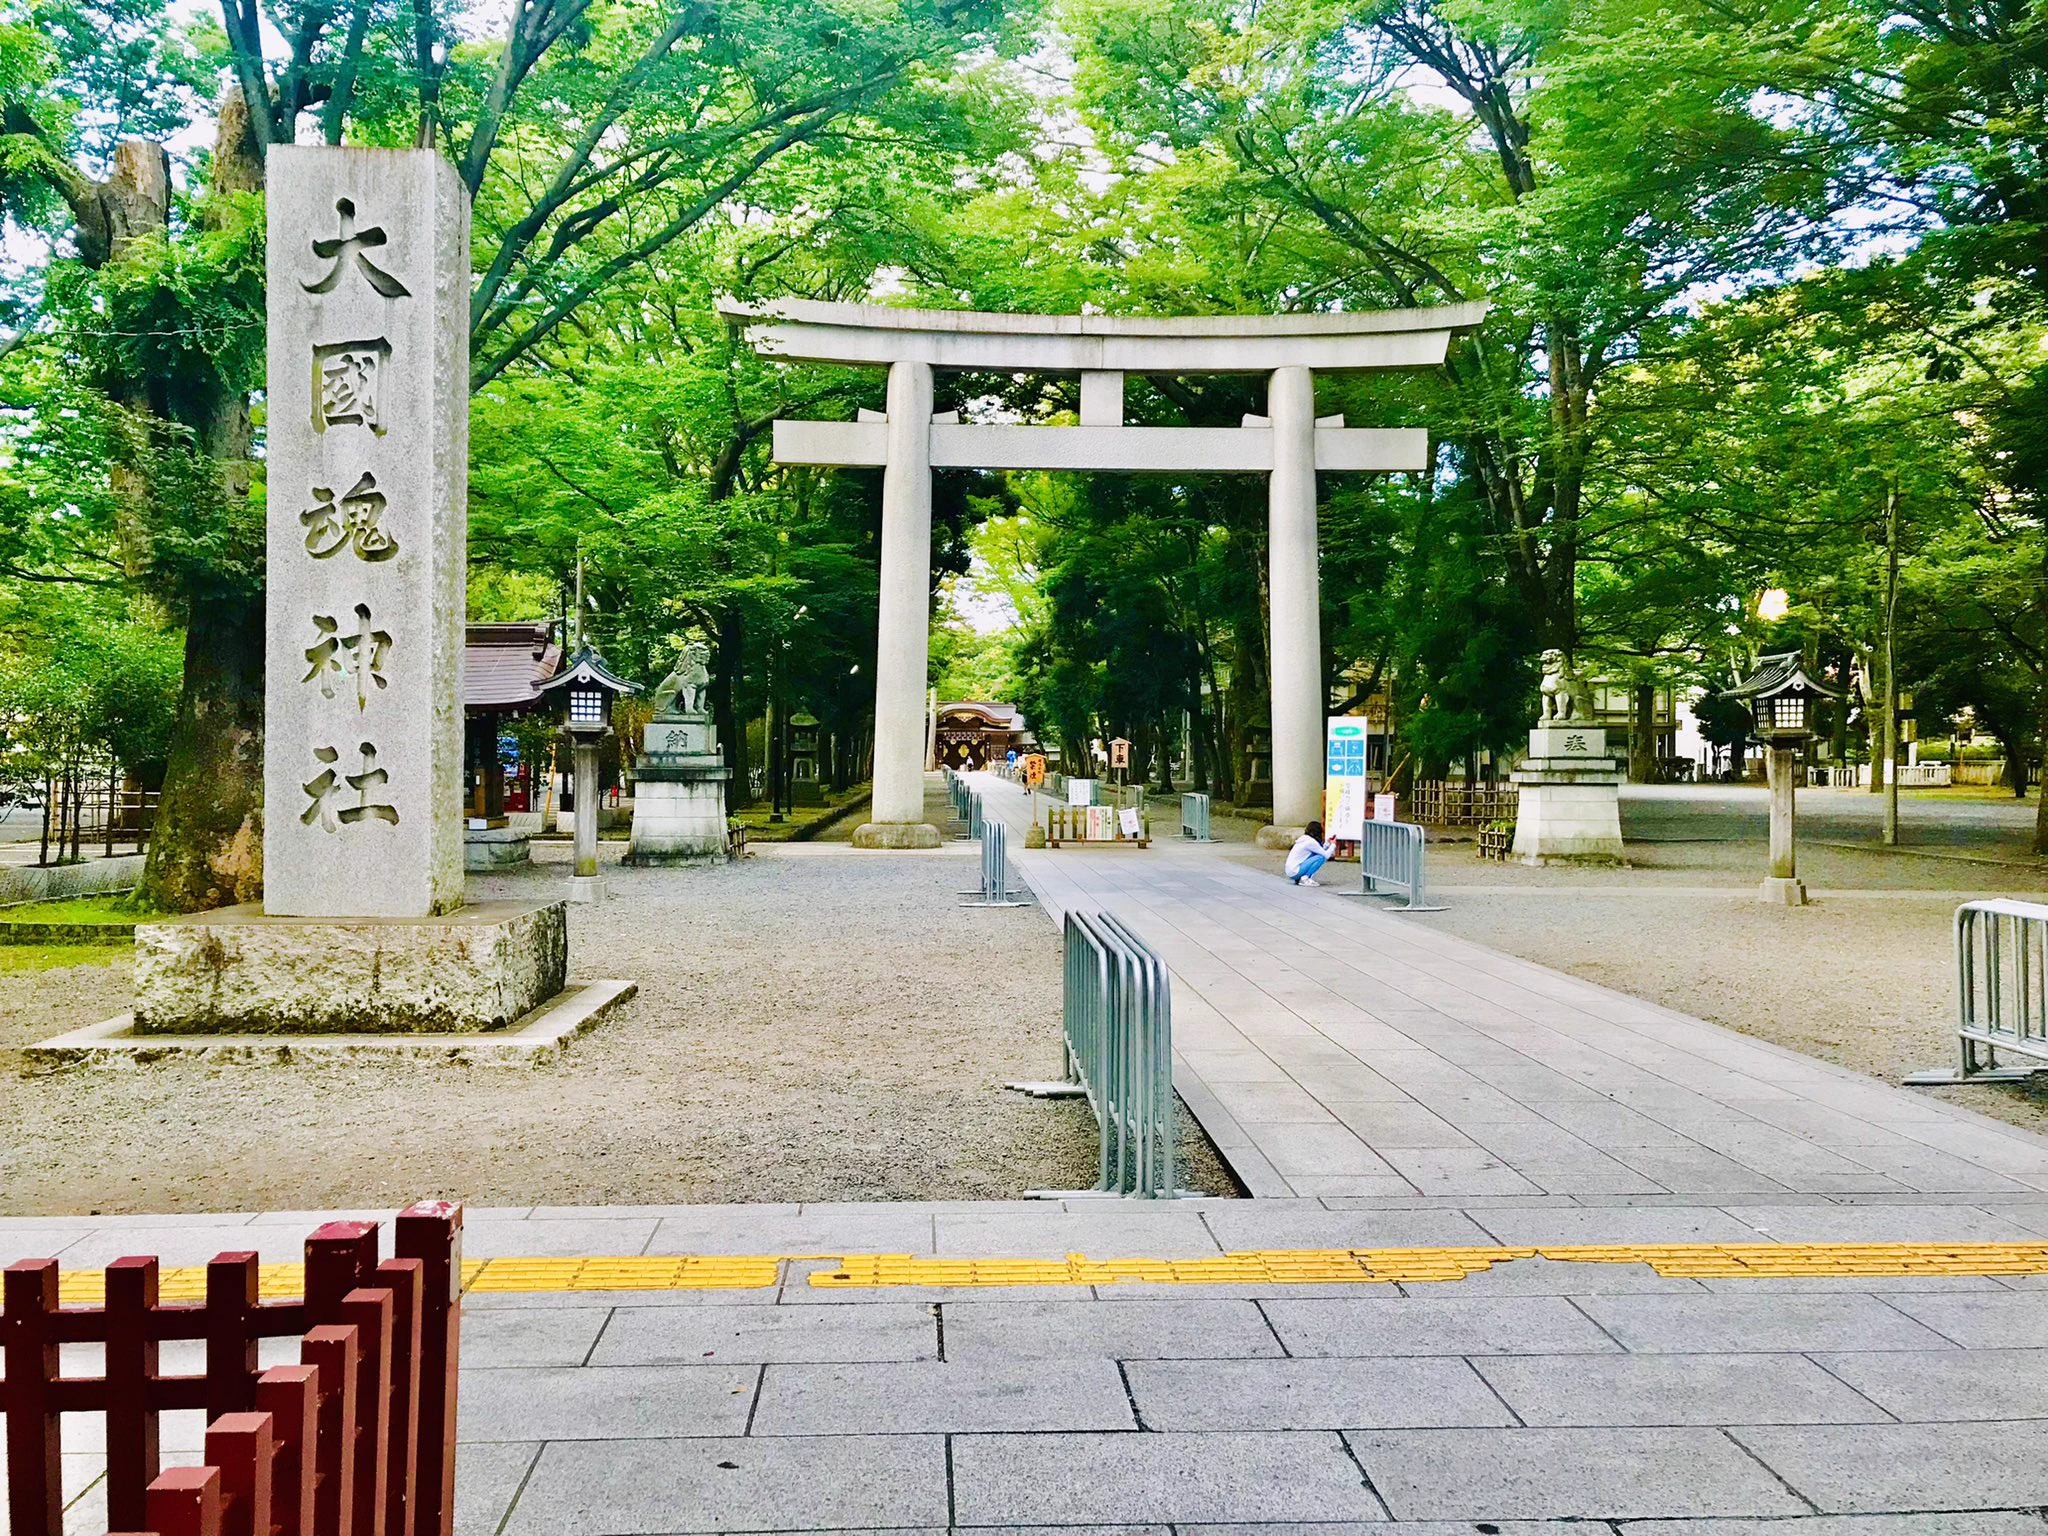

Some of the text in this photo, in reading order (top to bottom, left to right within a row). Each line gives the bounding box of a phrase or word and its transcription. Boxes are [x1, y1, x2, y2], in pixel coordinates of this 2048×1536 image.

[300, 196, 412, 834] 大國魂神社
[665, 729, 688, 749] 納
[1564, 734, 1587, 751] 奉
[1115, 743, 1126, 765] 下車
